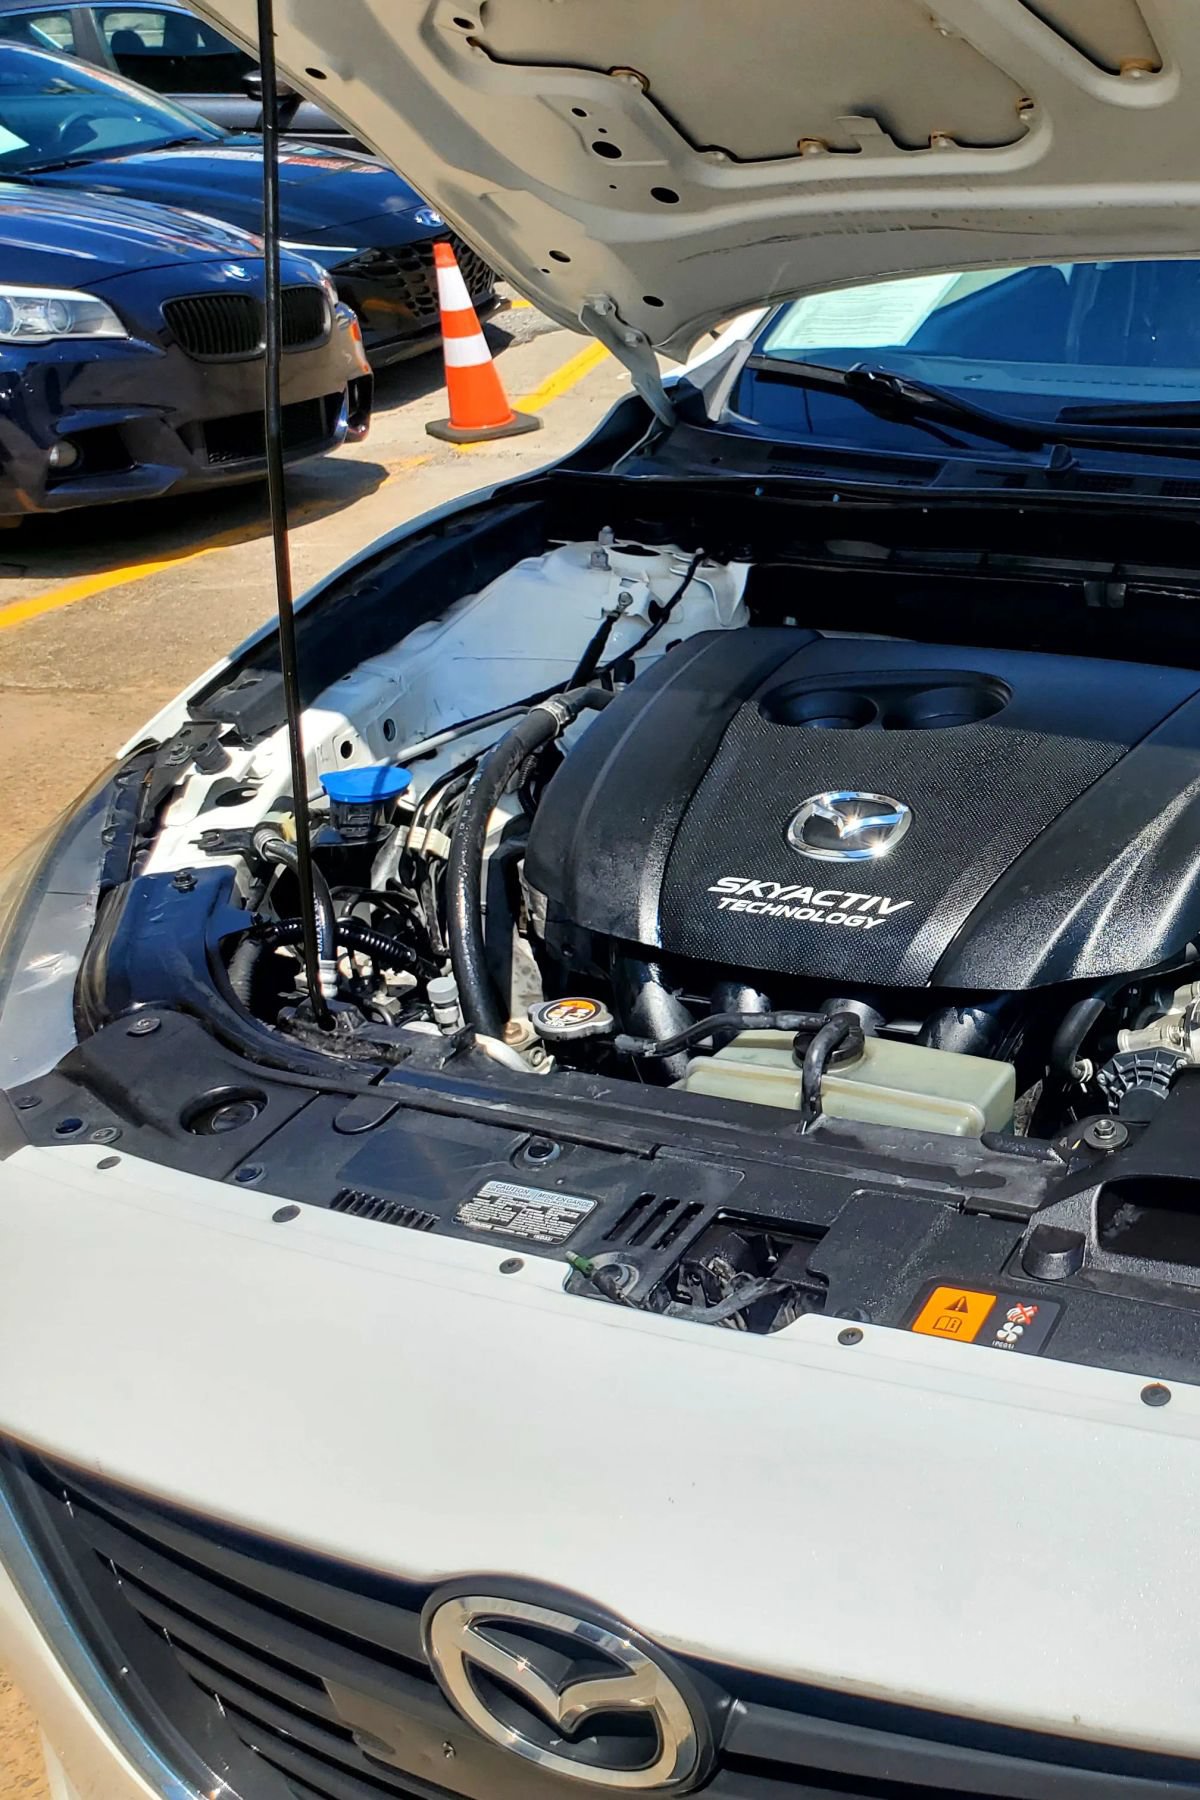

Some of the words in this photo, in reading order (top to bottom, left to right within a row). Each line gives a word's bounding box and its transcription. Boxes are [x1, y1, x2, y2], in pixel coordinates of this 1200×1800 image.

[707, 876, 914, 915] SKYACTIV
[717, 897, 886, 929] TECHNOLOGY
[496, 1184, 529, 1194] CAUTION
